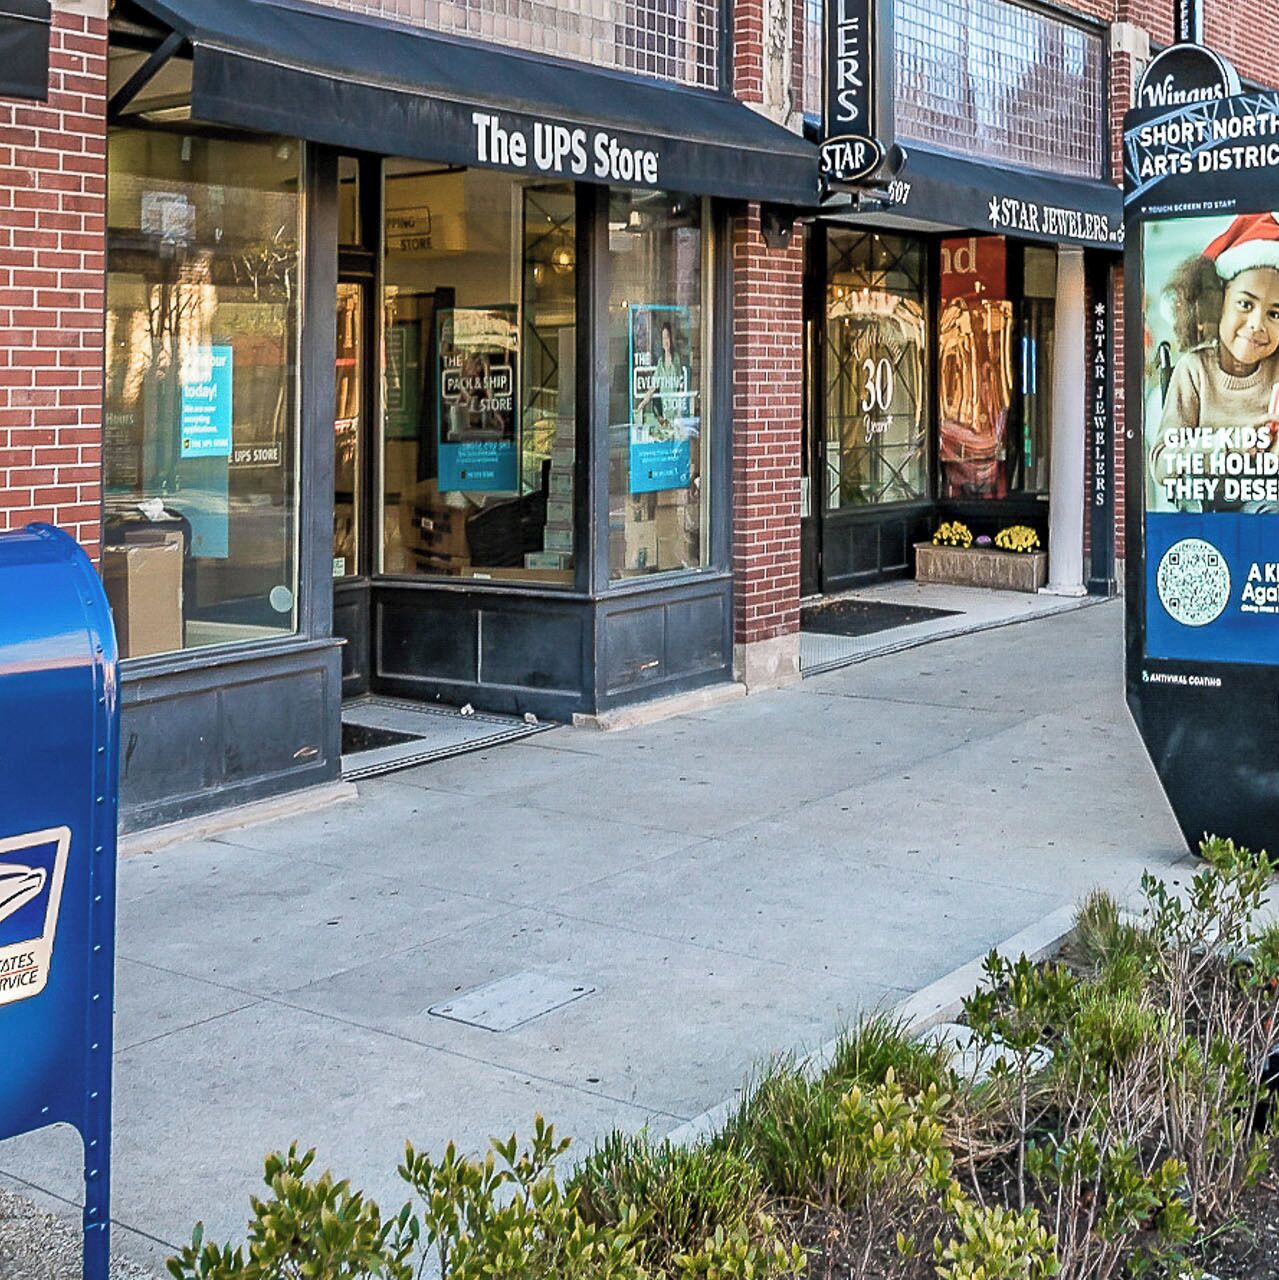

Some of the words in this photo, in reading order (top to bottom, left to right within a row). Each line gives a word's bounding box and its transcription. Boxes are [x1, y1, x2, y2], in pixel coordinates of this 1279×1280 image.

[1143, 74, 1224, 106] Winans
[1139, 120, 1206, 147] SHORT
[472, 111, 528, 167] The
[532, 120, 588, 175] UPS
[593, 131, 659, 184] Store
[821, 142, 865, 172] STAR
[1140, 152, 1193, 178] ARTS
[888, 180, 911, 205] 607
[1001, 199, 1040, 229] STAR
[1042, 205, 1110, 243] JEWELERS
[443, 354, 463, 368] THE
[634, 352, 651, 366] THE
[1095, 319, 1105, 379] STAR
[447, 377, 474, 392] PACK
[475, 376, 482, 390] &
[483, 374, 507, 390] SHIP
[861, 357, 894, 412] 30
[480, 397, 513, 412] STORE
[1094, 385, 1106, 506] JEWELERS
[1163, 428, 1213, 449] GIVE
[1219, 426, 1271, 449] KIDS
[234, 449, 251, 463] UPS
[253, 448, 278, 461] STORE
[1163, 454, 1204, 475] THE
[1163, 478, 1218, 502] THEY
[1247, 563, 1261, 581] A
